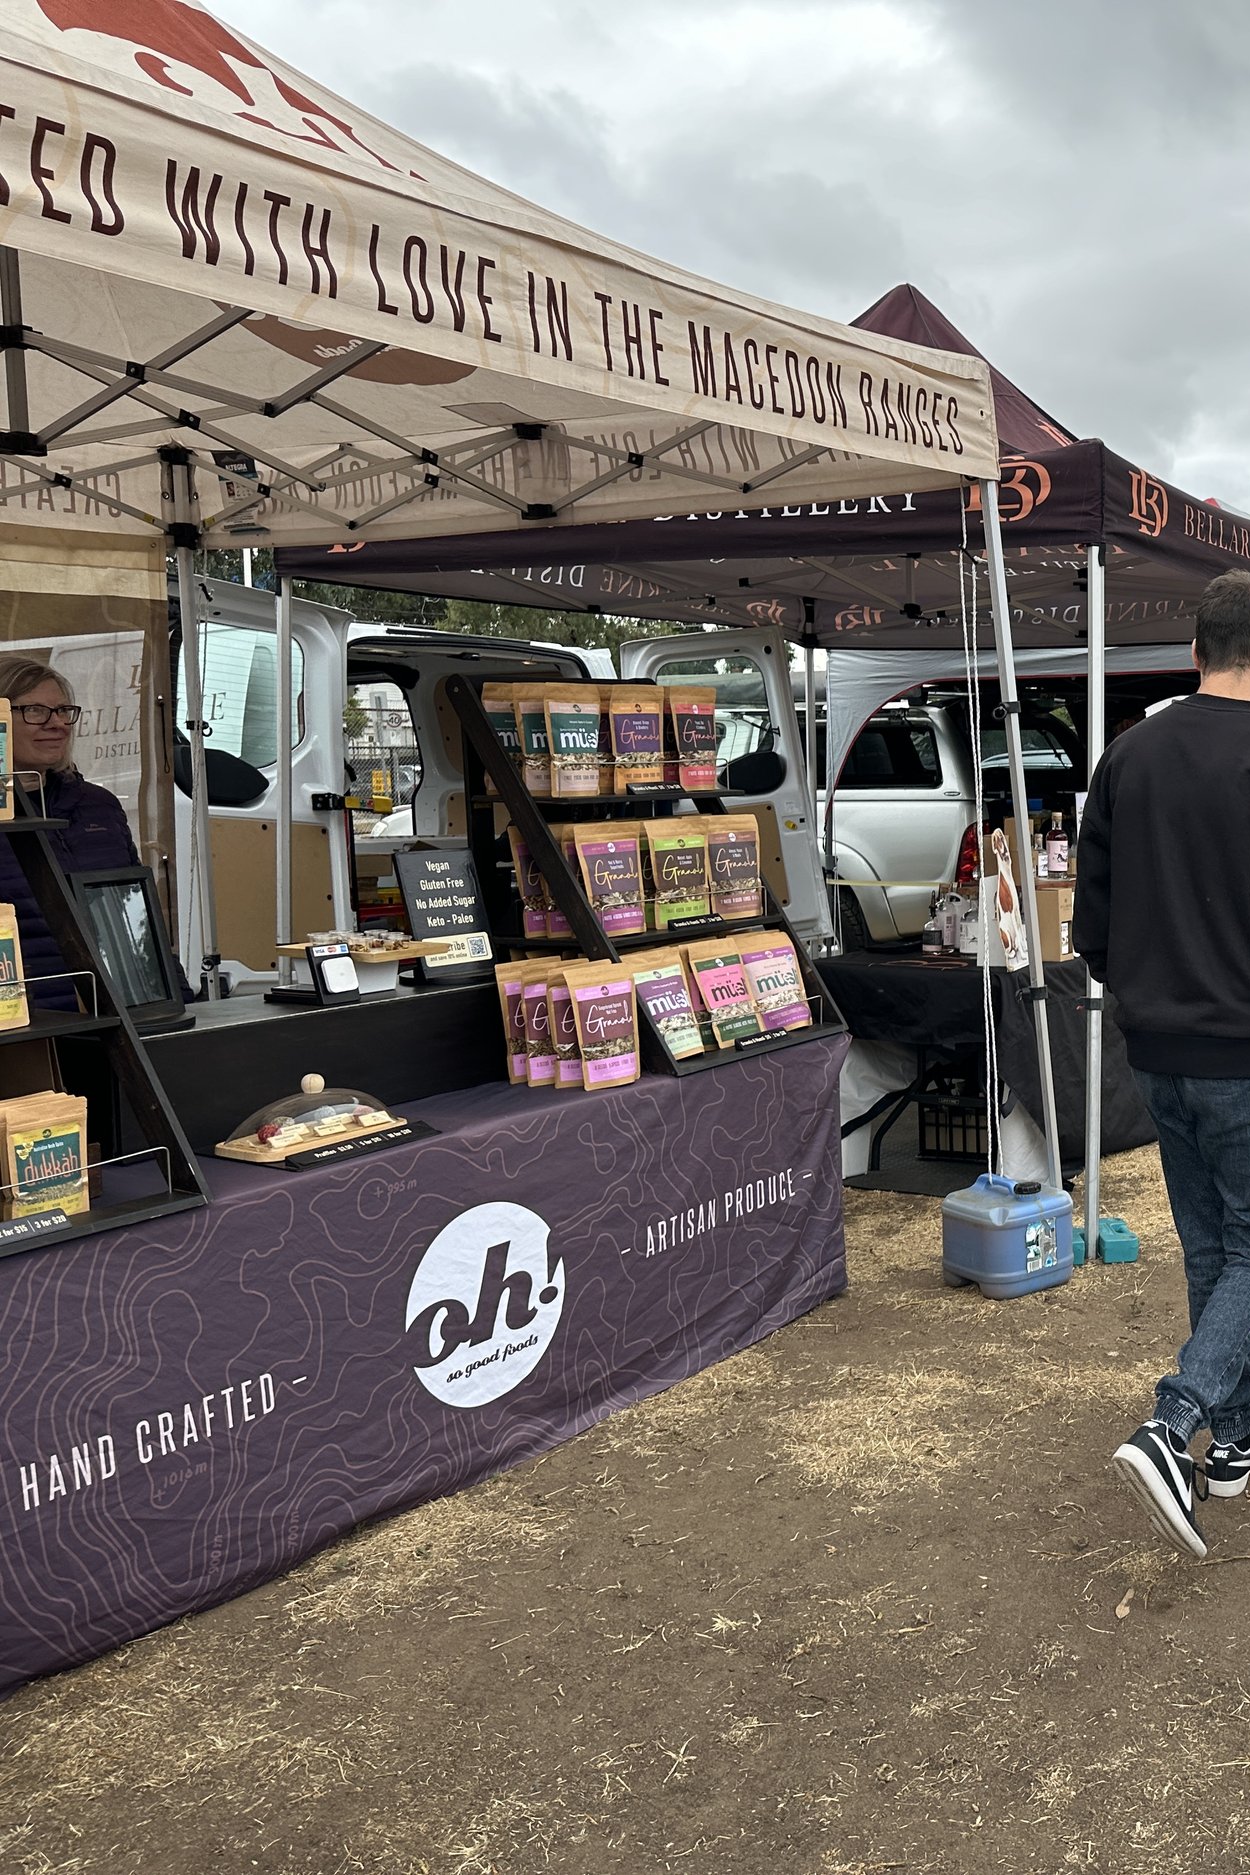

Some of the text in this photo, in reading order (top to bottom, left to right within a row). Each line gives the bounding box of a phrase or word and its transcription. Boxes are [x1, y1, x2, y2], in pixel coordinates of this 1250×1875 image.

[165, 159, 338, 299] WITH
[369, 223, 502, 343] LOVE
[526, 271, 573, 362] IN
[593, 291, 669, 387] THE
[687, 320, 848, 430] MACEDON
[860, 371, 963, 456] RANGES
[425, 860, 450, 873] Vegan
[714, 847, 757, 877] Granola
[420, 877, 464, 891] Gluten Free
[416, 895, 475, 910] No Added Sugar
[426, 916, 445, 928] Keto
[451, 913, 474, 925] Paleo
[387, 1178, 417, 1195] 995 m
[4, 1228, 13, 1237] for
[14, 1225, 28, 1235] $15
[34, 1221, 41, 1229] 3
[41, 1219, 52, 1228] for
[52, 1214, 67, 1225] $20
[646, 1199, 716, 1258] ARTISAN
[725, 1168, 796, 1222] PRODUCE
[406, 1230, 562, 1369] oh!
[446, 1334, 539, 1384] so good foods
[20, 1434, 116, 1511] HAND
[136, 1373, 275, 1465] CRAFTED
